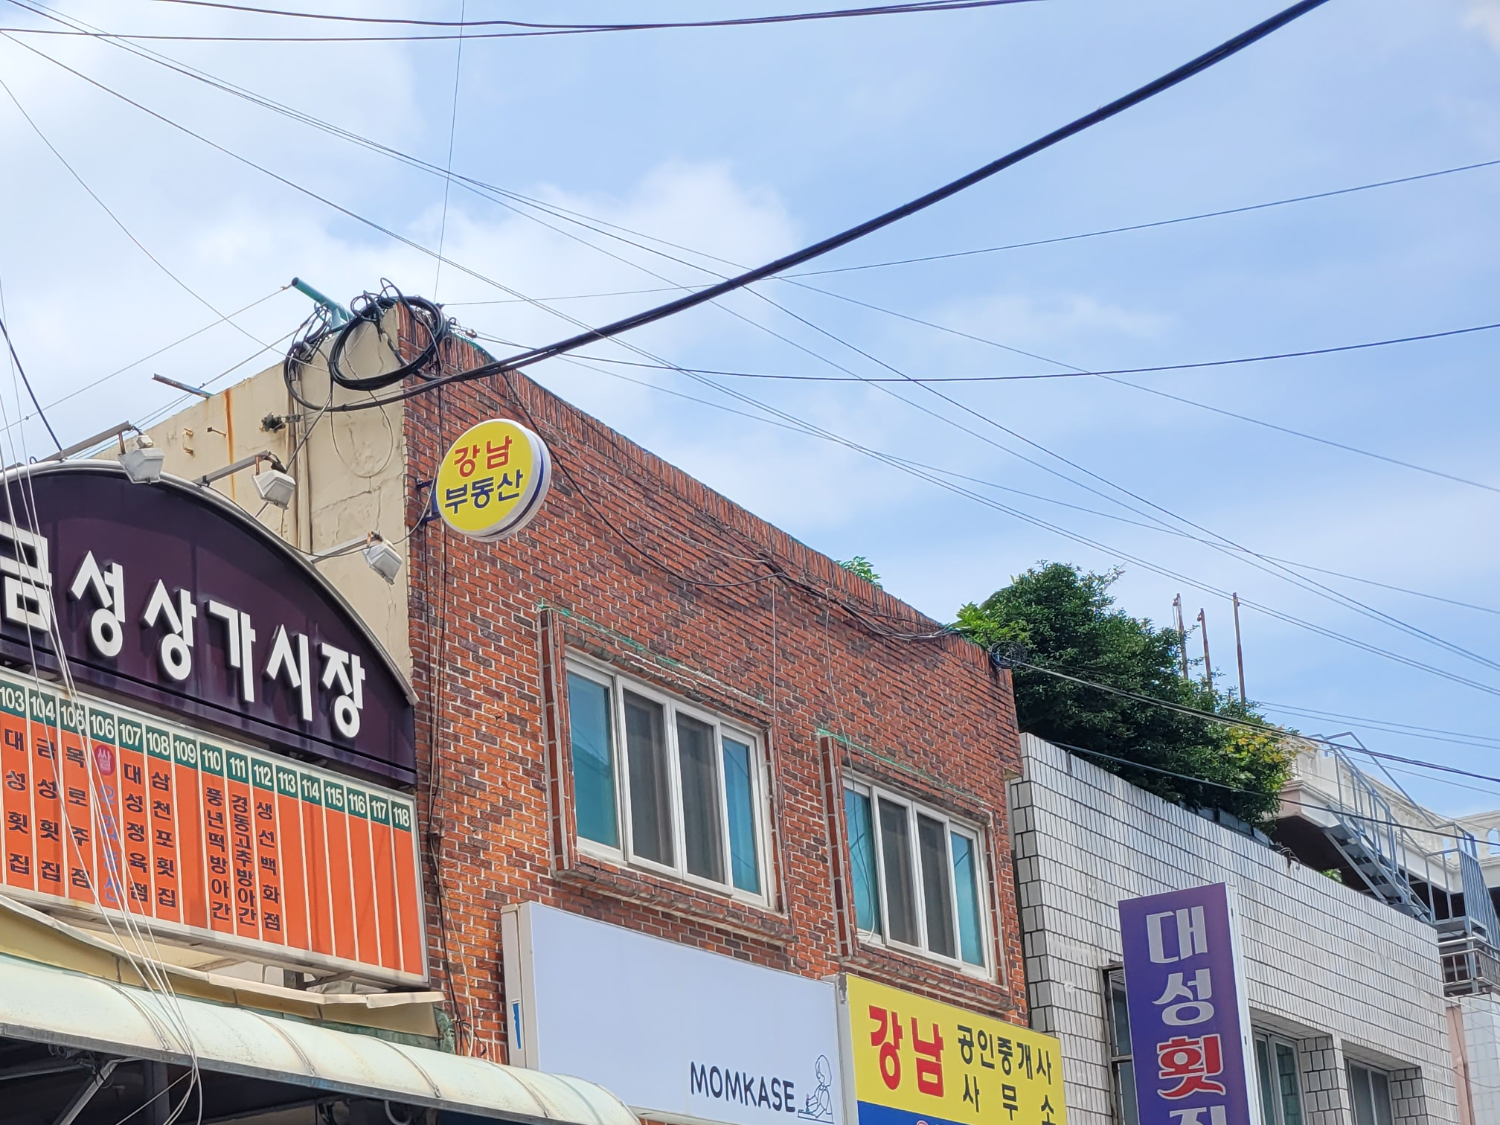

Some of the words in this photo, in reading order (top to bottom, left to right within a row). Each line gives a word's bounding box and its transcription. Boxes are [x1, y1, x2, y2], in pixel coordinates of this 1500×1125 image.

[453, 434, 513, 478] 강남
[444, 468, 524, 514] 부동산
[0, 686, 25, 712] 103
[30, 696, 55, 721] 104
[91, 714, 115, 739] 106
[120, 723, 142, 747] 107
[147, 732, 169, 755] 108
[175, 739, 197, 764] 109
[202, 749, 221, 771] 110
[229, 757, 246, 778] 111
[254, 764, 273, 786] 112
[278, 772, 296, 793] 113
[4, 728, 31, 876] 대성횟집
[302, 779, 320, 800] 114
[326, 786, 343, 807] 115
[36, 737, 62, 884] 금성횟집
[349, 793, 366, 814] 116
[371, 799, 387, 820] 117
[65, 746, 92, 890] 목로주점
[393, 806, 410, 828] 118
[123, 762, 149, 903] 대성정육점
[150, 770, 177, 909] 삼천포횟집
[205, 785, 231, 922] 풍년떡방아간
[256, 800, 281, 932] 생선백화점
[868, 1004, 944, 1098] 강남
[956, 1023, 1053, 1086] 공인중개사
[689, 1059, 797, 1114] MOMKASE
